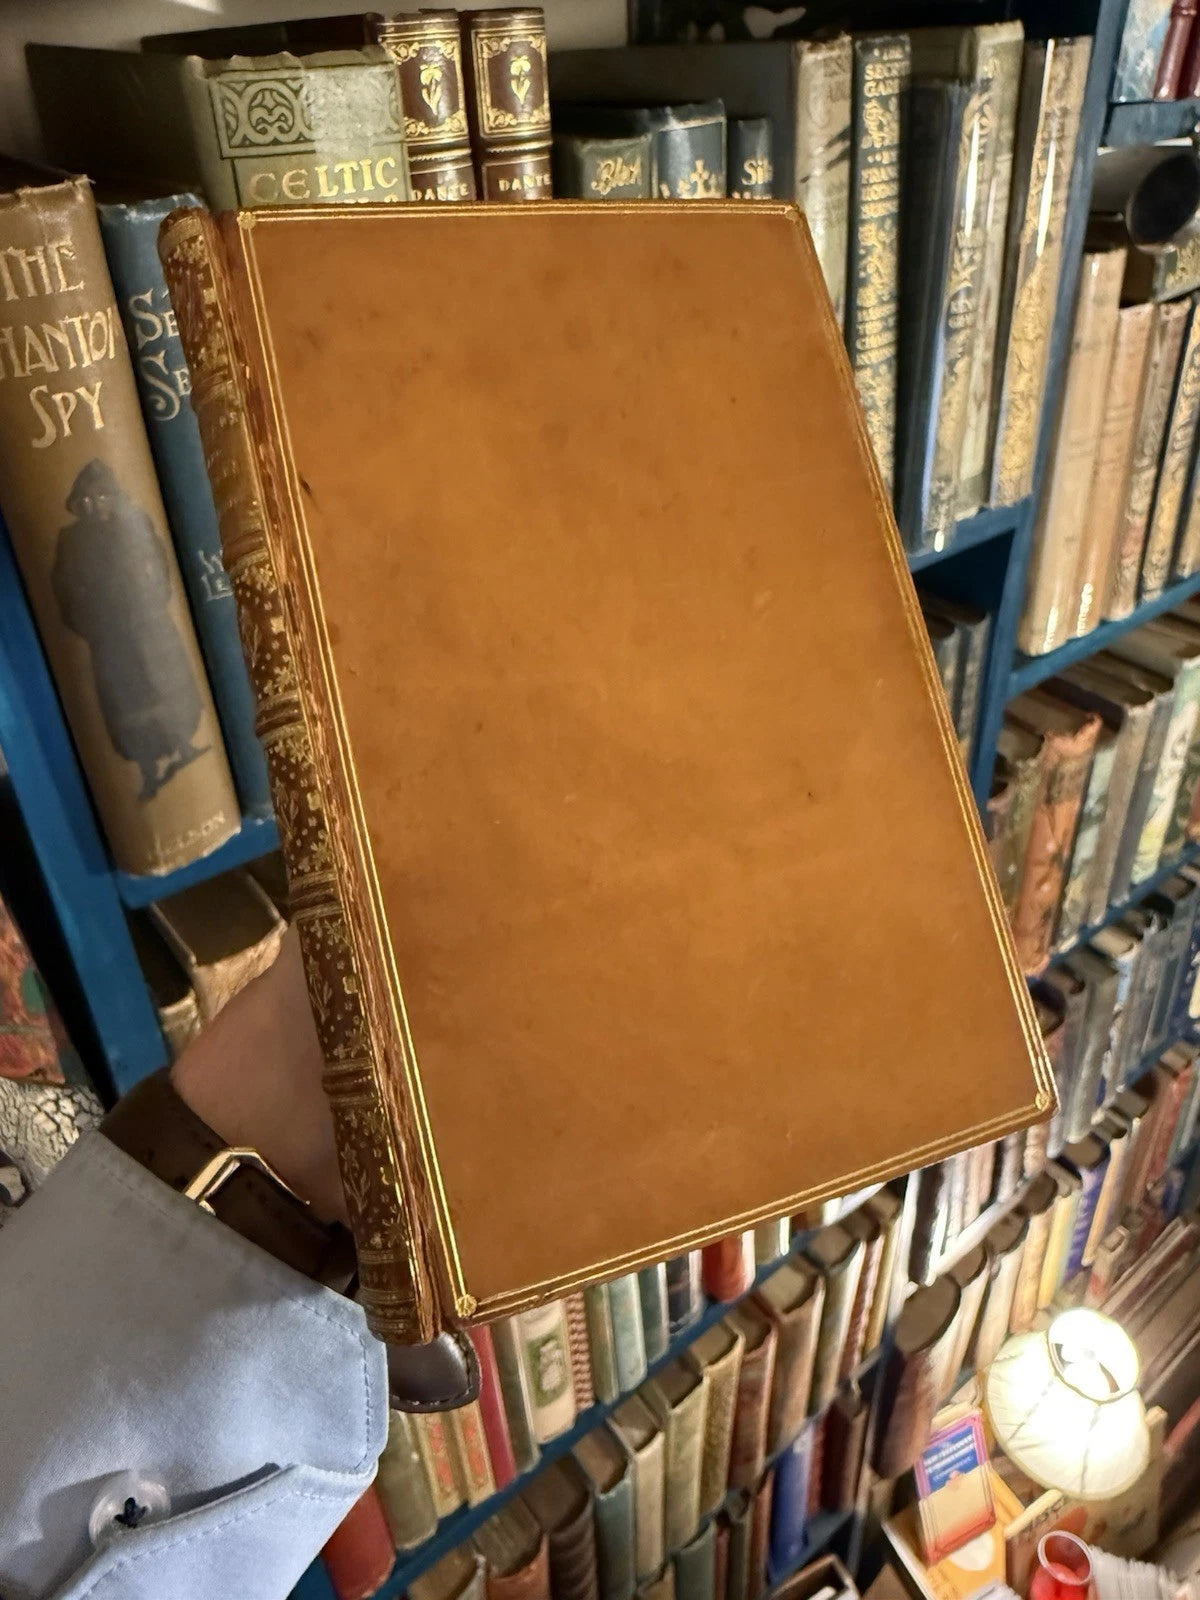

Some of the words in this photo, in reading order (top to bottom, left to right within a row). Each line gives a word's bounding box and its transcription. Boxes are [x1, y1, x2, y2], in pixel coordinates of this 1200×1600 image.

[250, 156, 399, 201] CELTIC
[411, 183, 471, 201] DANTE
[499, 174, 552, 192] DANTE
[0, 237, 86, 301] THE
[0, 306, 116, 379] HANTO
[30, 381, 105, 448] SPY
